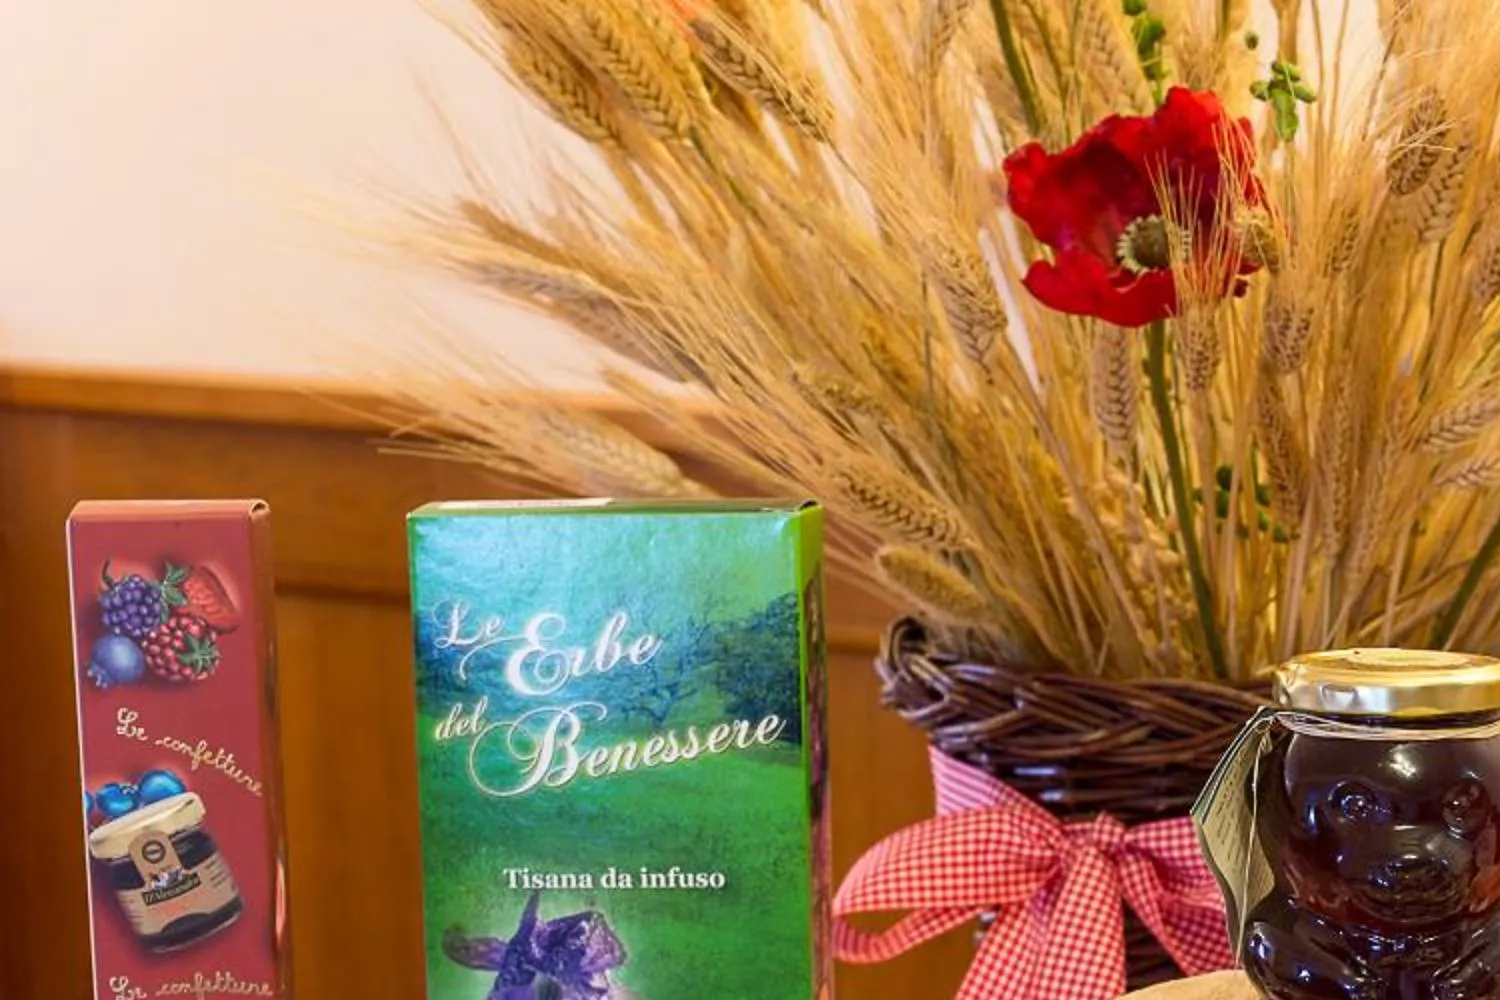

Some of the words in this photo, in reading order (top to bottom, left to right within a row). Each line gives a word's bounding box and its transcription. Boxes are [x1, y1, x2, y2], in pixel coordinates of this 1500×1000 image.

[431, 600, 501, 650] Le
[459, 610, 664, 696] Erbe
[435, 697, 488, 742] del
[470, 702, 787, 797] Benessere
[504, 868, 593, 890] Tisana
[601, 867, 633, 890] da
[640, 866, 726, 890] infuso
